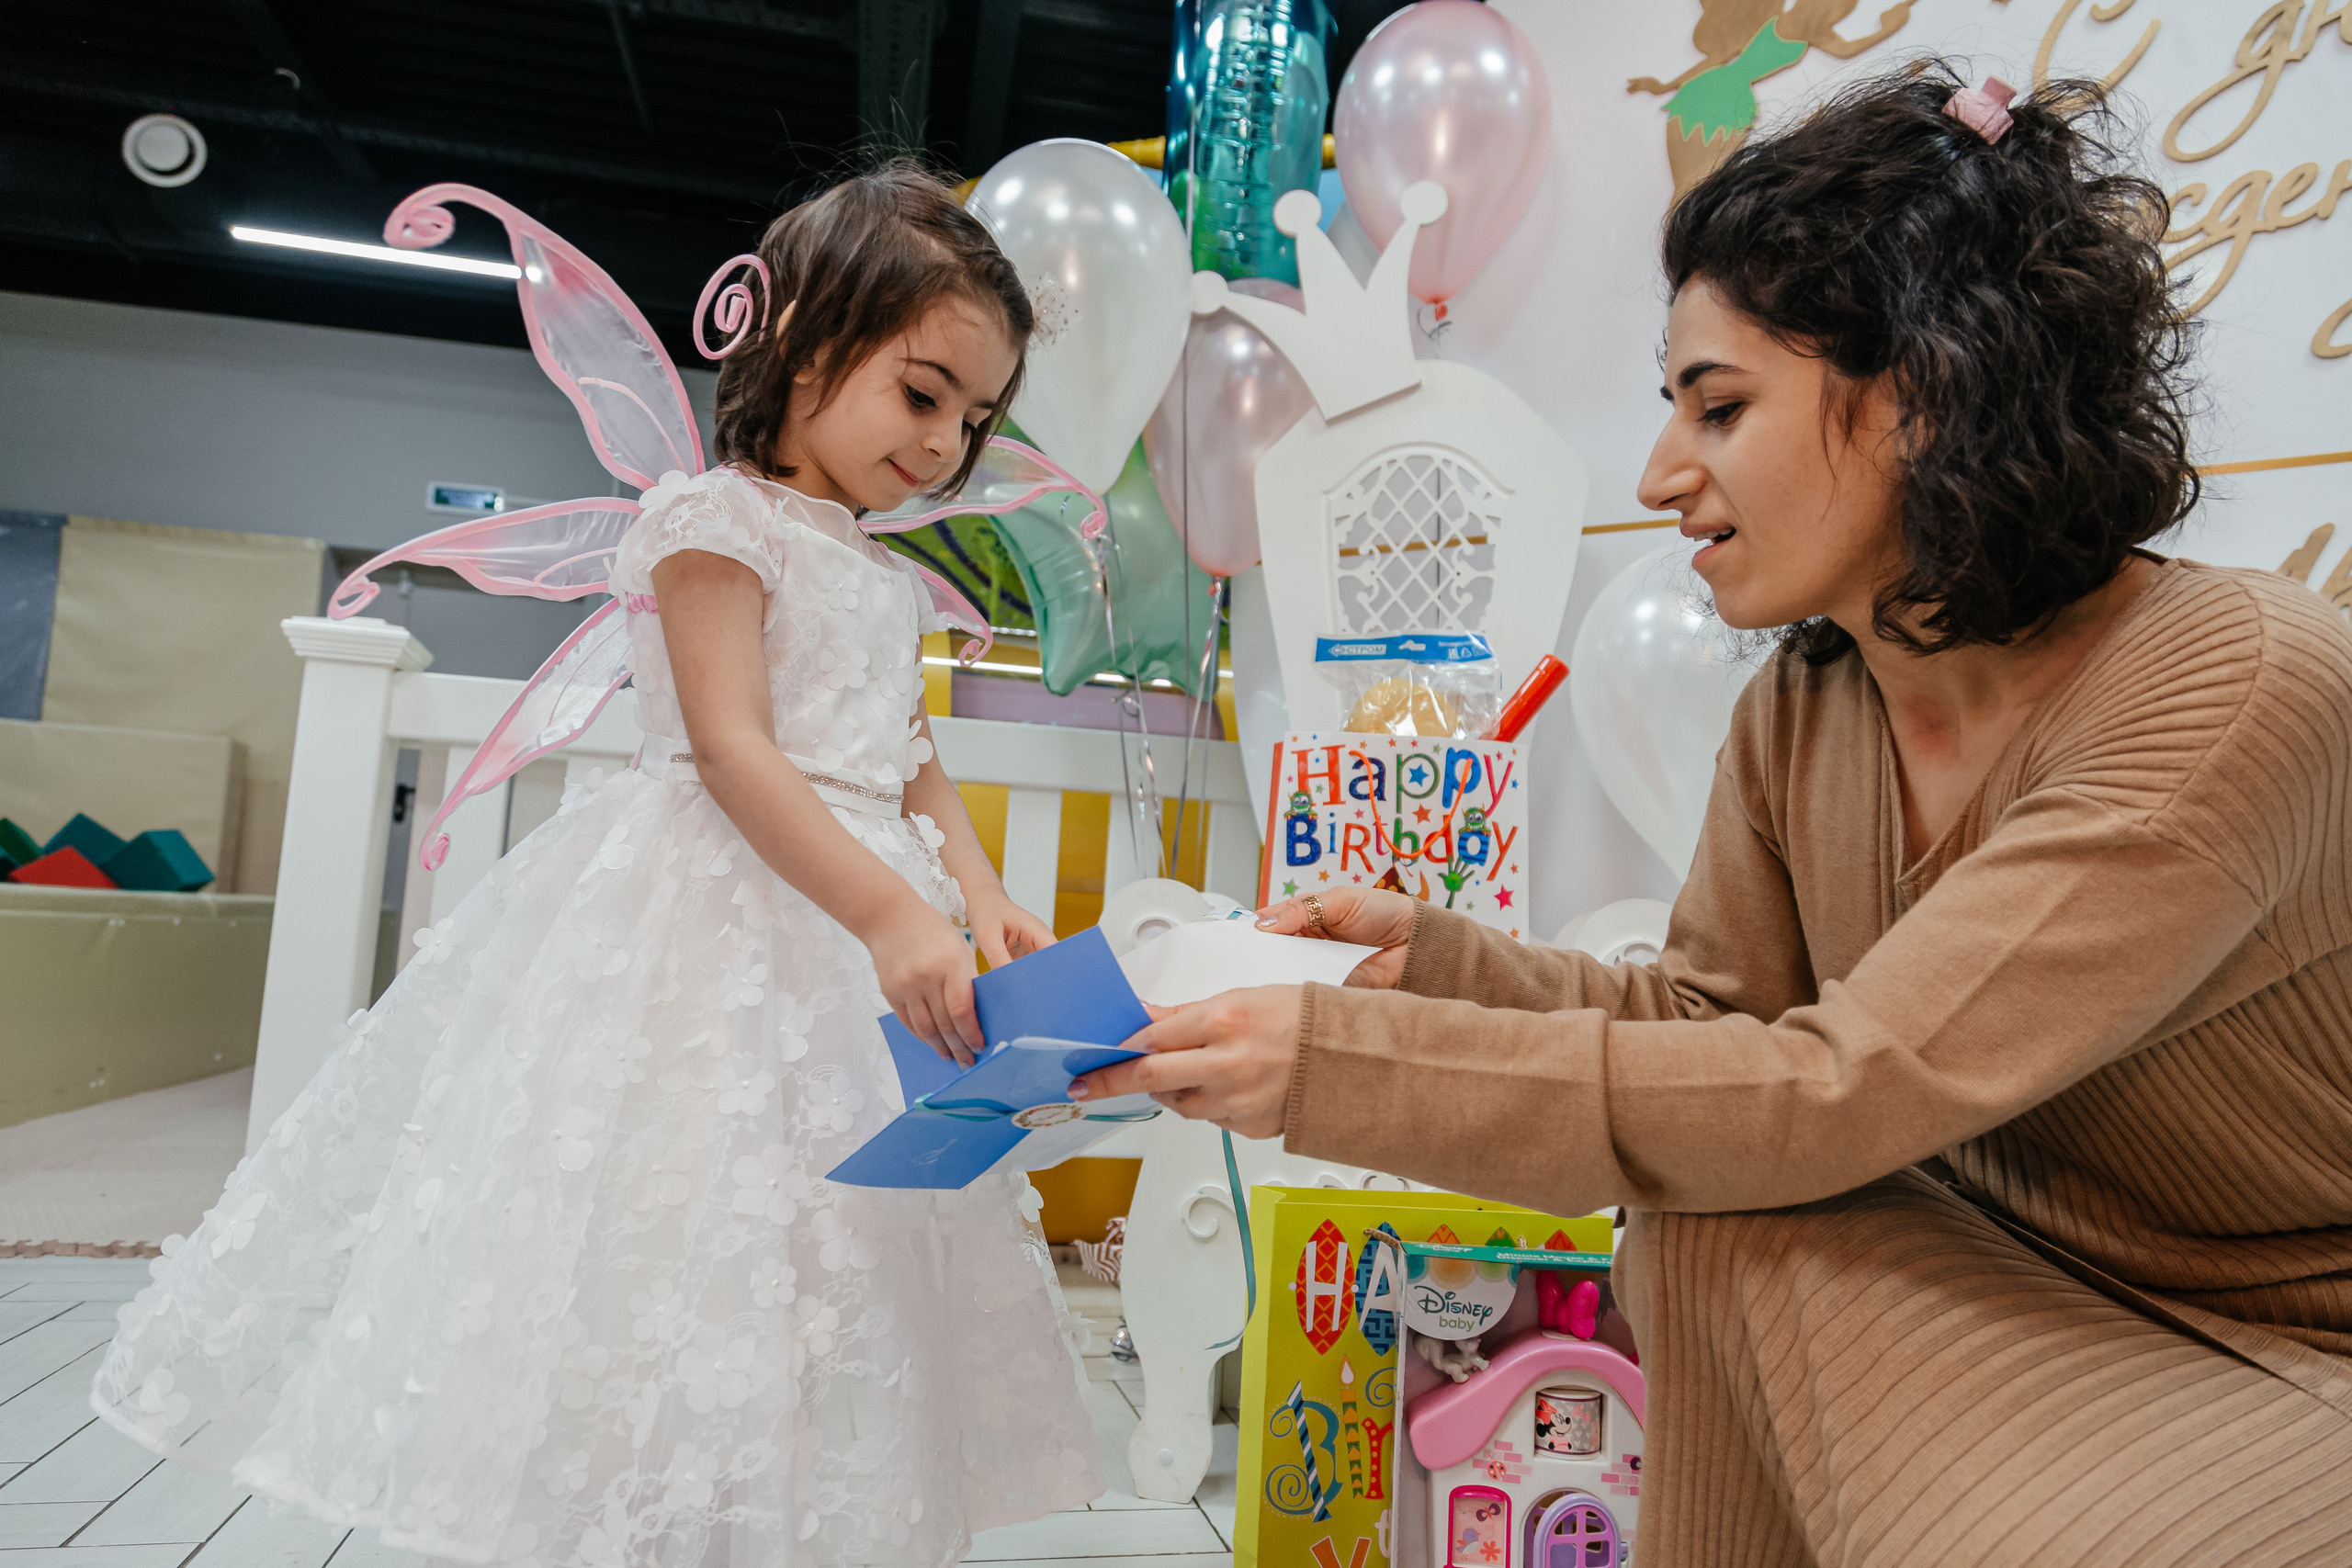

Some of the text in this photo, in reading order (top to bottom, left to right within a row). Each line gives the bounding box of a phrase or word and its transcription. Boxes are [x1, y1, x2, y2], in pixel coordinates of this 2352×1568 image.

[1291, 744, 1514, 816] Happy
[1414, 1285, 1493, 1326] Disney
[1439, 1315, 1476, 1333] baby
